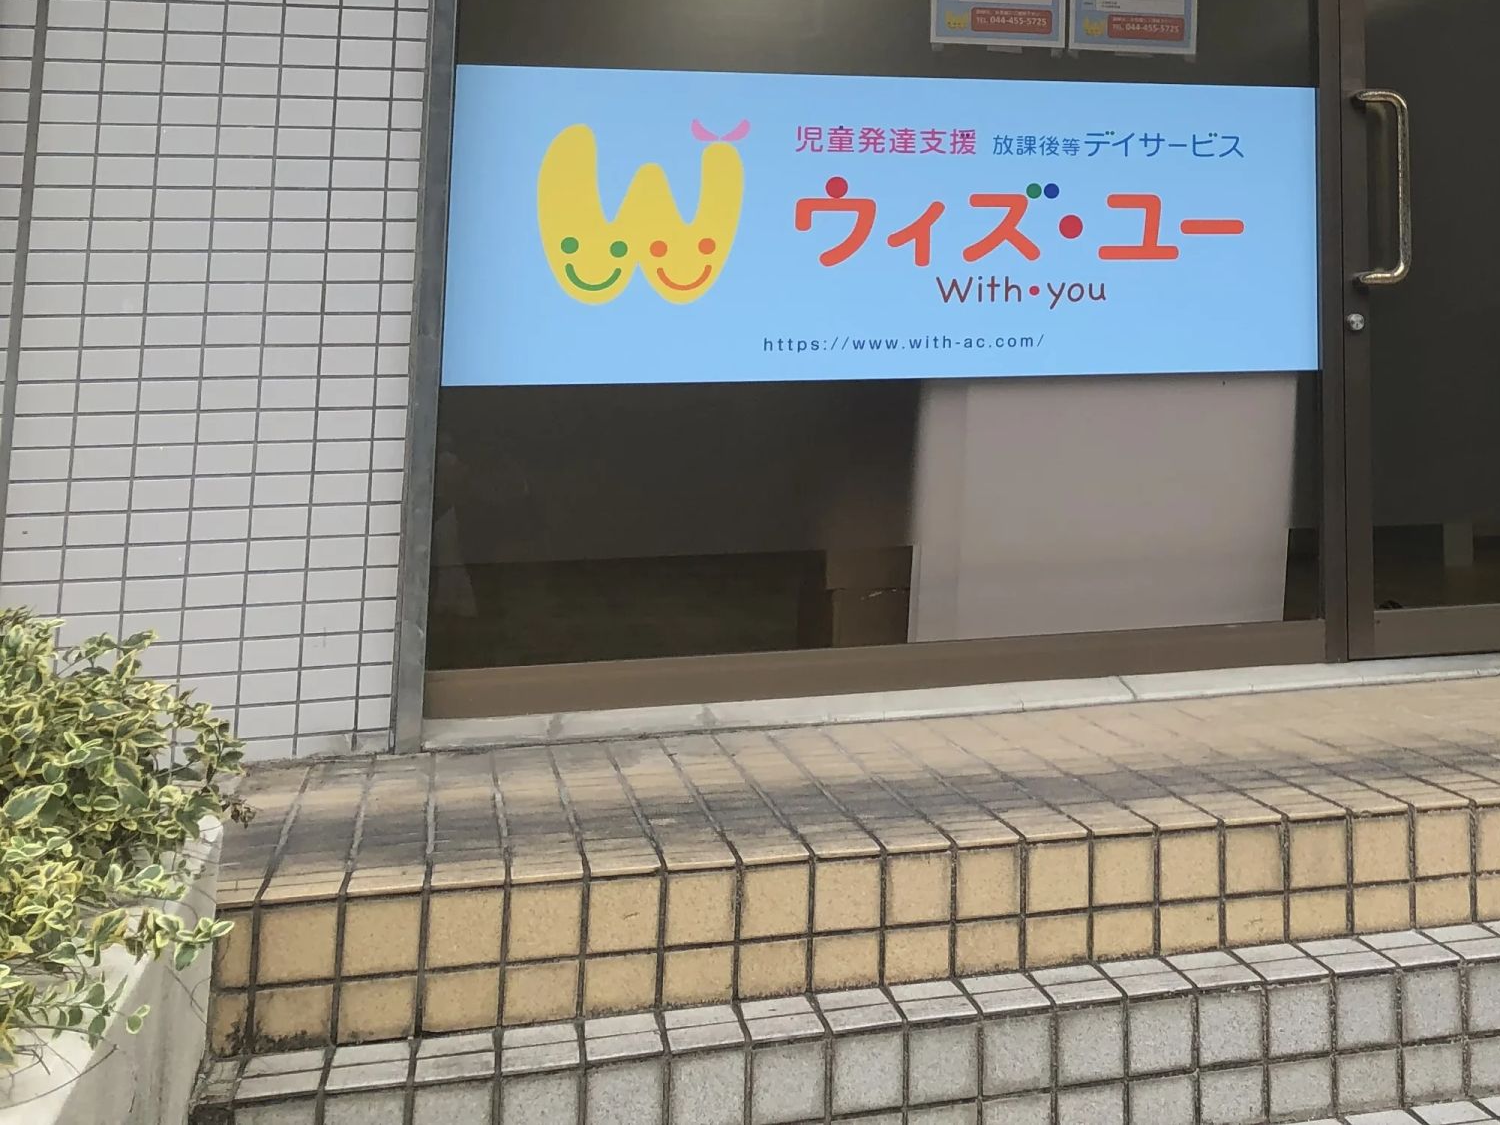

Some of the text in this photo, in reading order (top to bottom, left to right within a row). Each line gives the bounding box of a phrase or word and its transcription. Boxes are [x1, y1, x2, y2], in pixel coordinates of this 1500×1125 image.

[795, 125, 1245, 158] 児童発達支援 放課後等デイサービス
[795, 176, 1245, 267] ウィズ・ユー
[763, 333, 1045, 352] https://www.with-ac.com/
